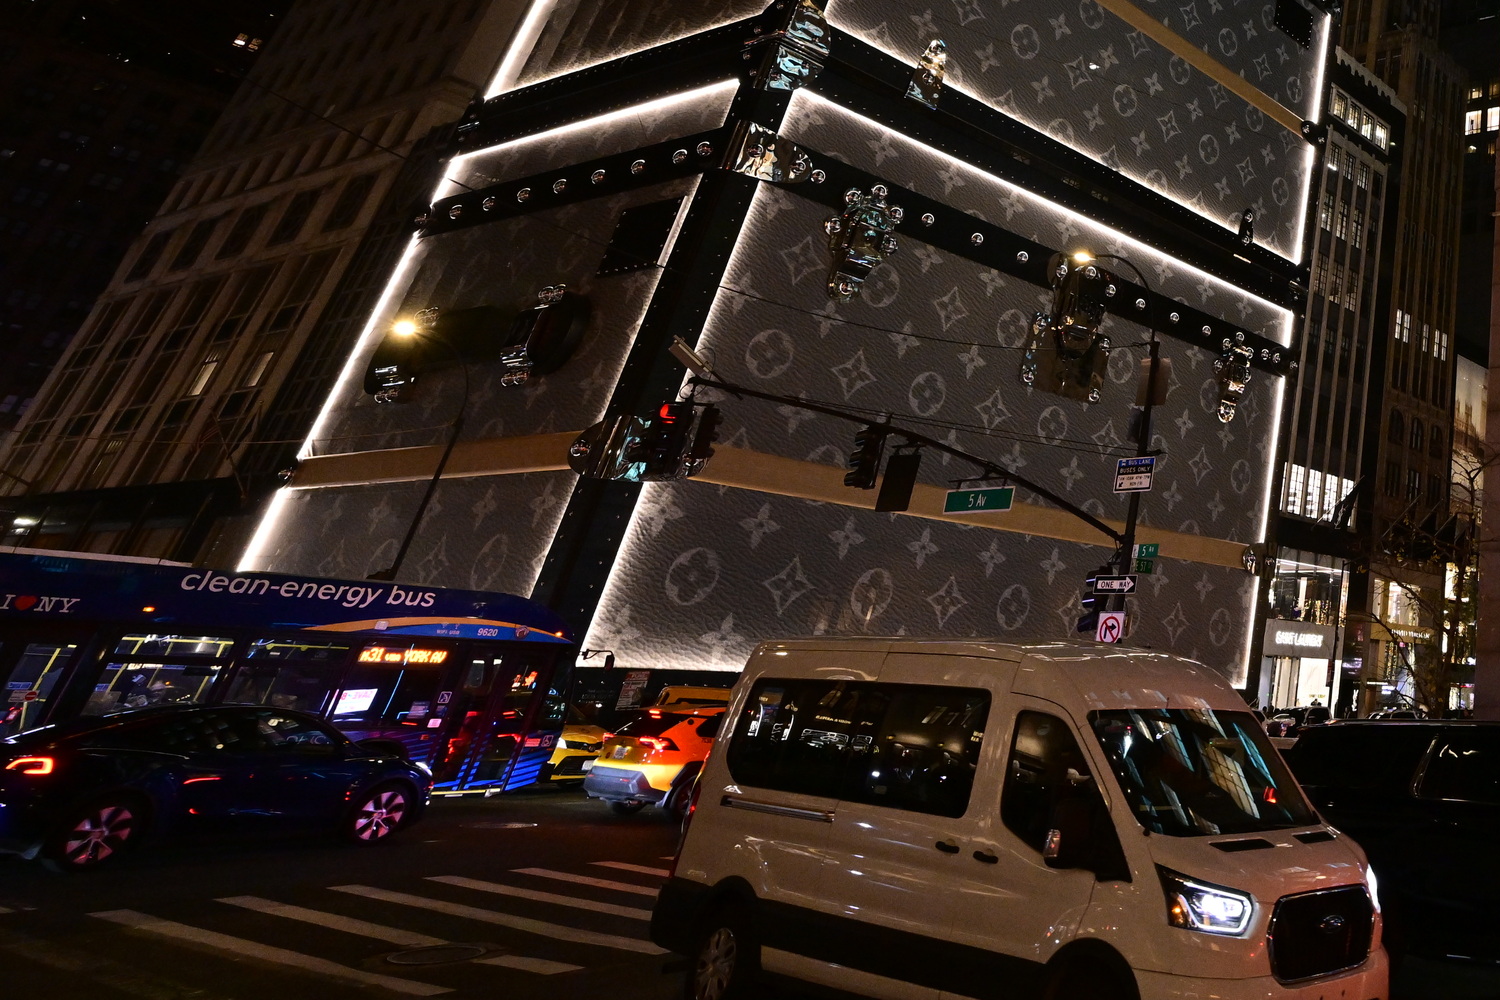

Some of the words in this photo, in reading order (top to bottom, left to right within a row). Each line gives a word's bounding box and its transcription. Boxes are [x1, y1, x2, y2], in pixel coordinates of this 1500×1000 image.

[1120, 466, 1136, 474] BUSES
[968, 494, 975, 508] 5
[975, 493, 987, 507] Av
[1142, 545, 1147, 557] 5
[181, 570, 383, 609] clean-energy
[386, 585, 436, 608] bus
[1100, 580, 1114, 589] ONE
[1119, 580, 1131, 589] WAY
[33, 596, 81, 613] NY
[477, 627, 498, 637] 9620
[403, 648, 432, 663] YORK
[430, 650, 447, 664] AV
